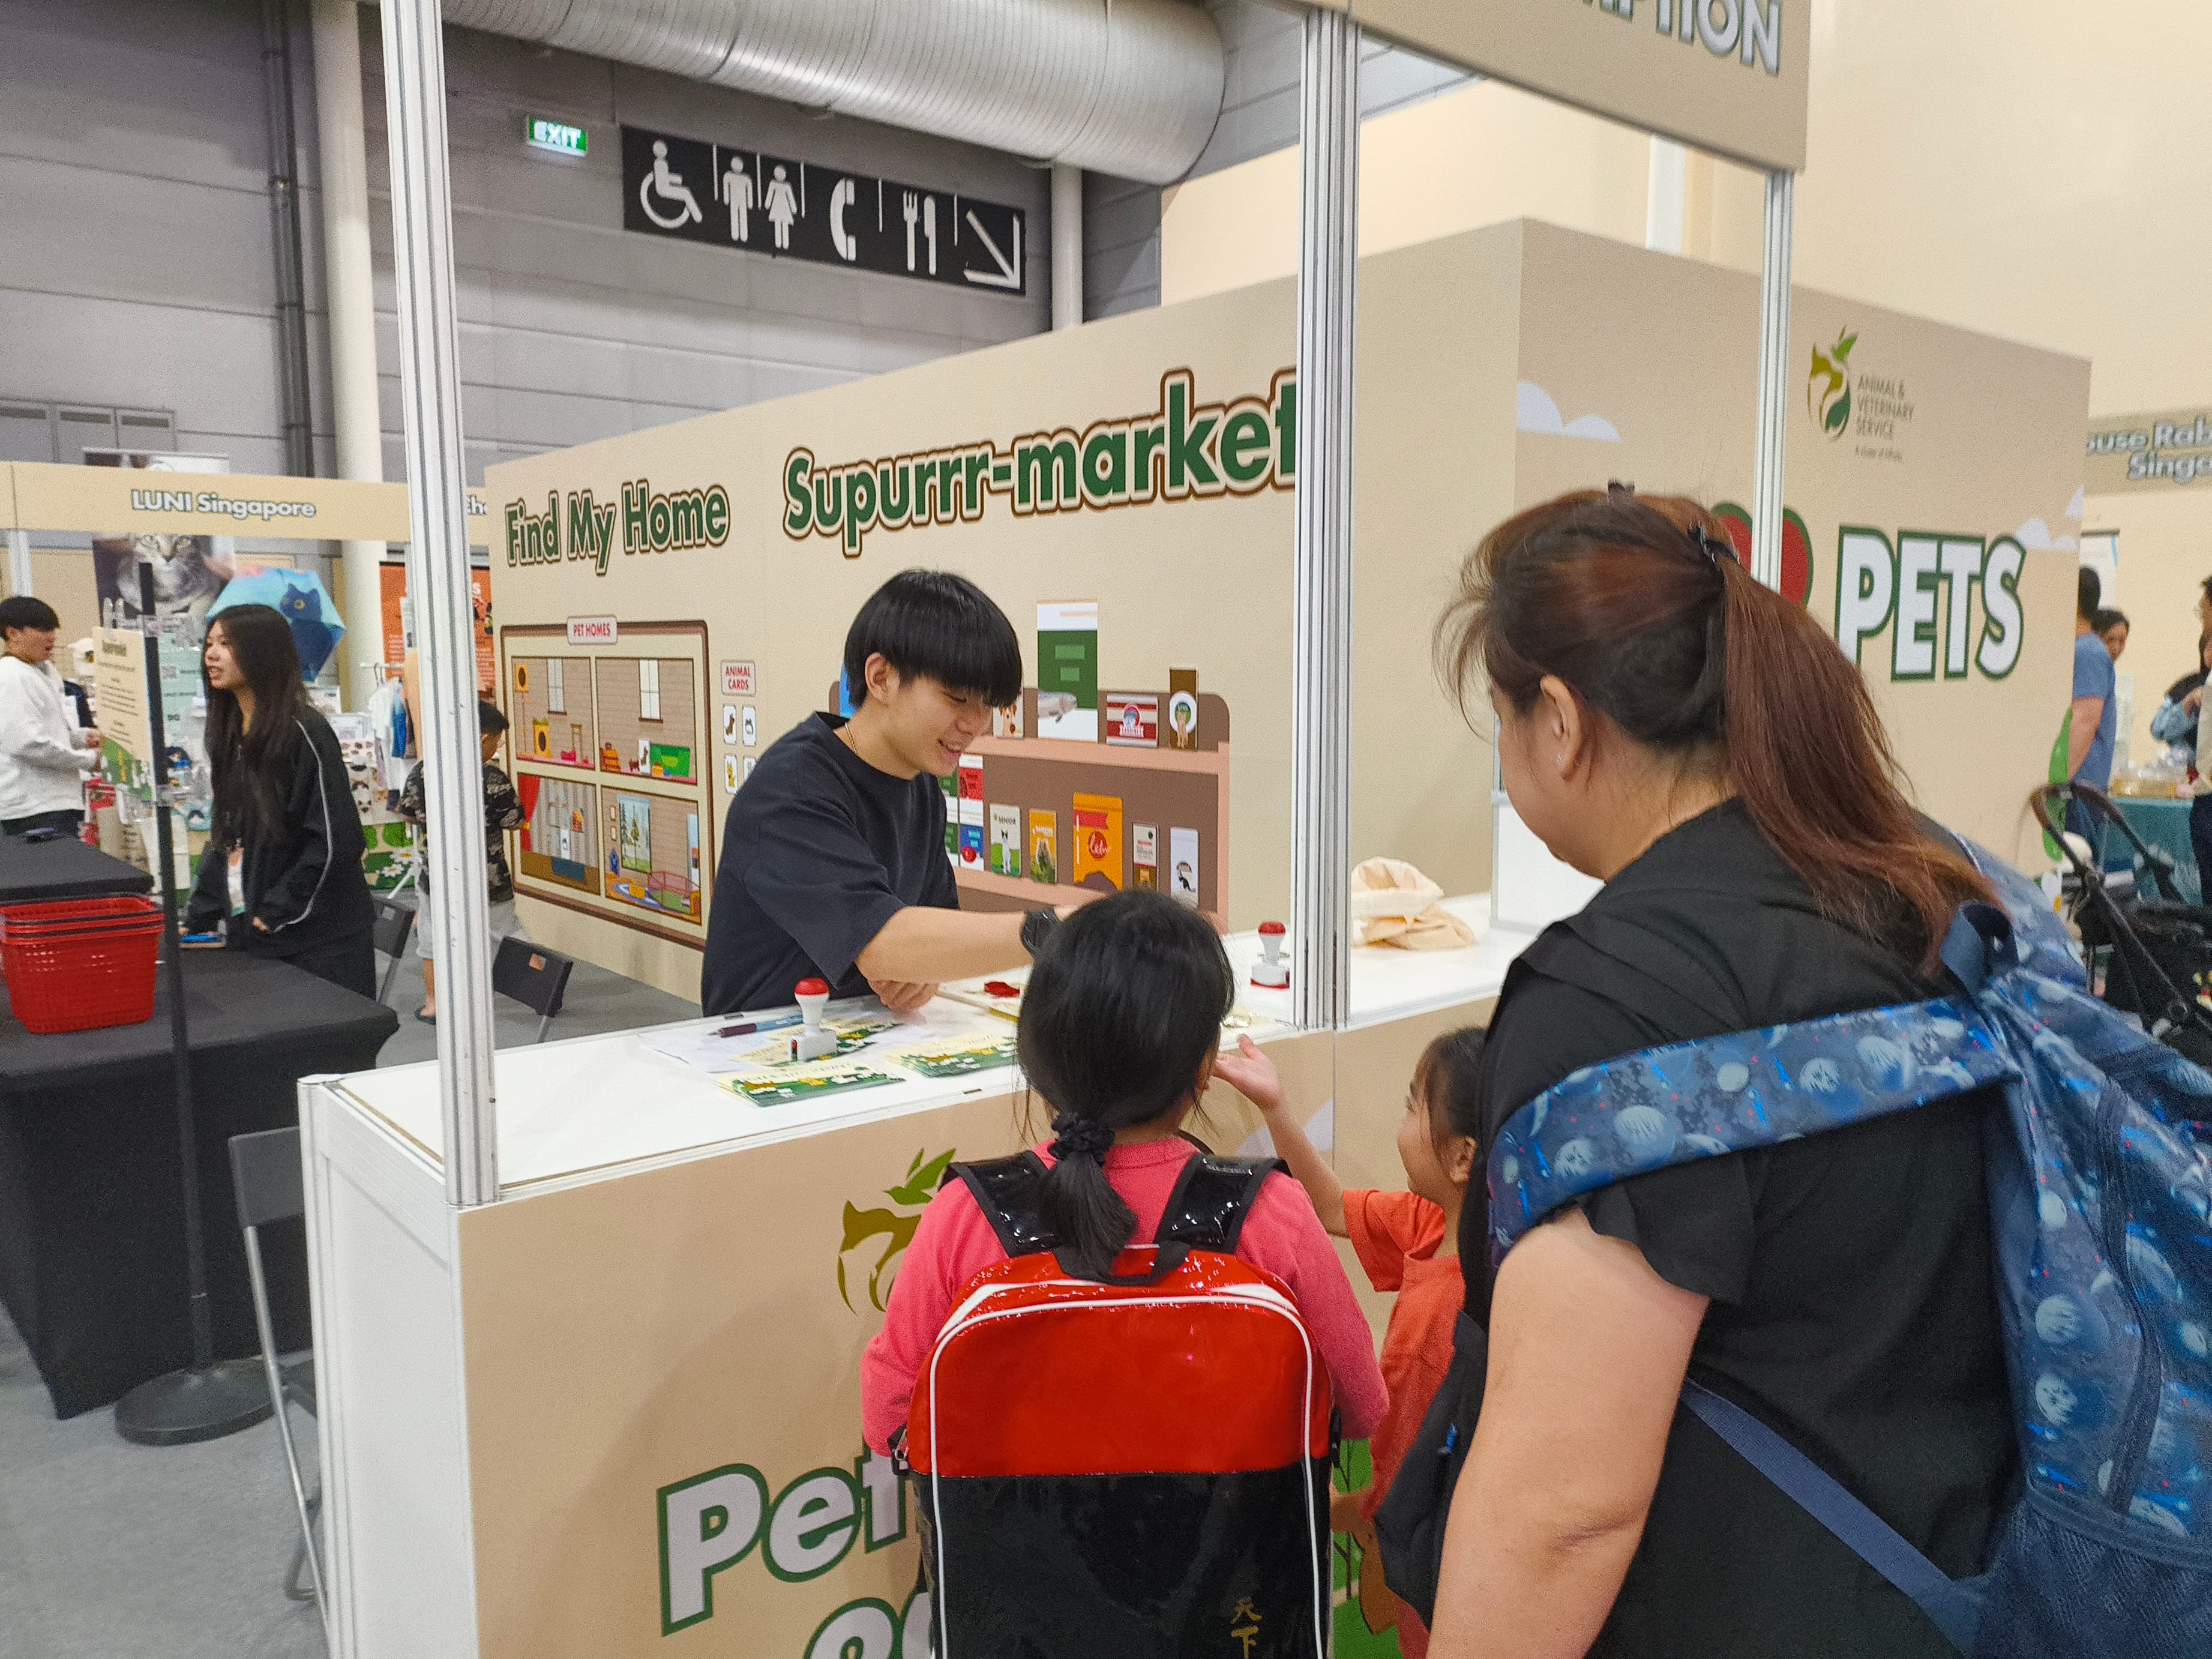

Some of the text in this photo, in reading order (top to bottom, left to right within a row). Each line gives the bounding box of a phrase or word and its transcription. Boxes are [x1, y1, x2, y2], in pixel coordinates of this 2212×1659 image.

[534, 120, 582, 149] EXIT
[1858, 375, 1895, 399] ANIMAL
[1857, 394, 1914, 423] VETERINARY
[1856, 415, 1894, 441] SERVICE
[783, 366, 1297, 558] Supurrr-market
[131, 489, 316, 521] LUNI Singapore
[505, 479, 730, 576] Find My Home
[1834, 525, 2027, 682] PETS
[573, 621, 611, 637] PET HOMES
[725, 666, 751, 678] ANIMAL
[727, 679, 750, 691] CARDS
[656, 1435, 907, 1637] Pet
